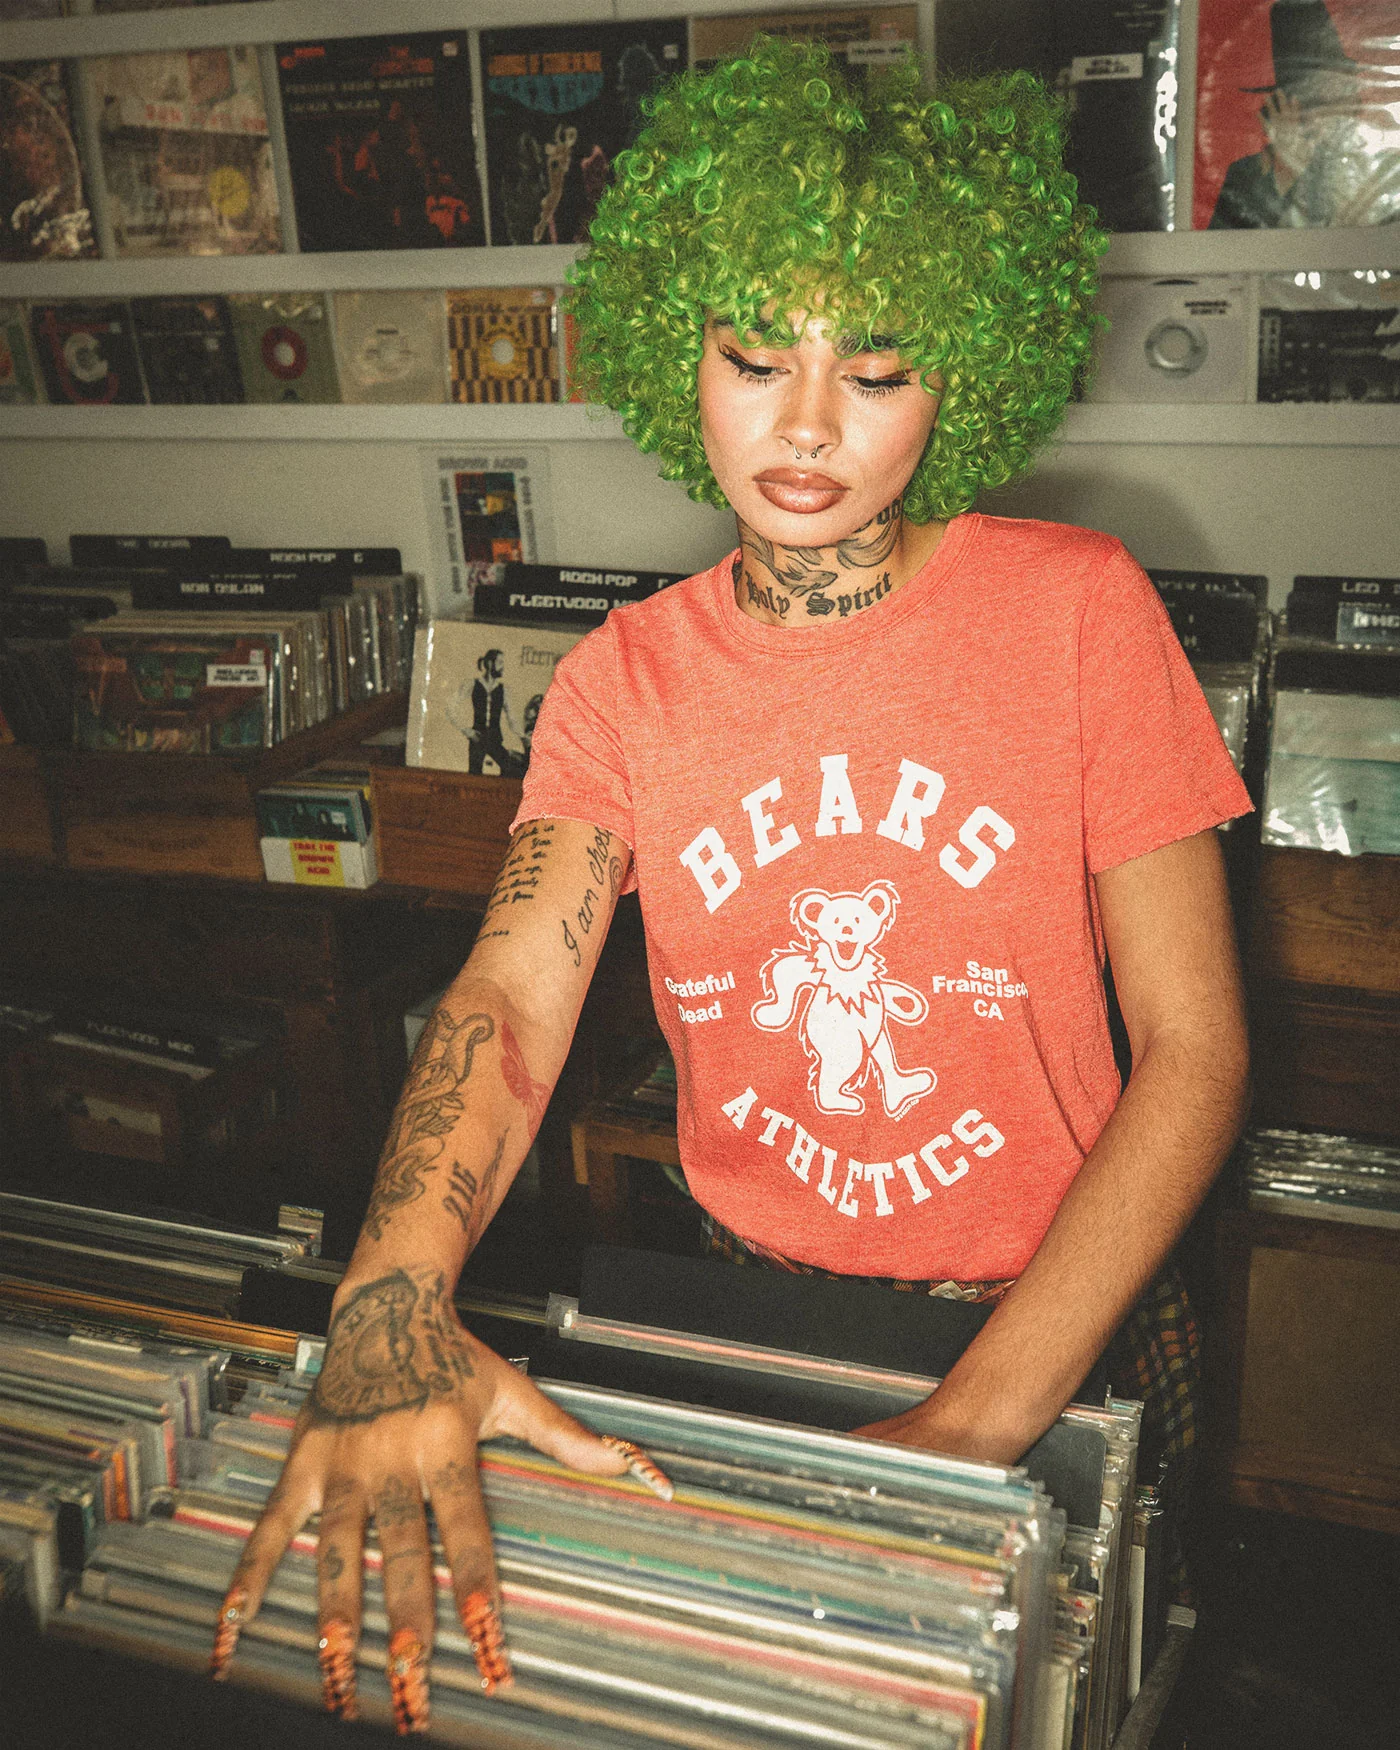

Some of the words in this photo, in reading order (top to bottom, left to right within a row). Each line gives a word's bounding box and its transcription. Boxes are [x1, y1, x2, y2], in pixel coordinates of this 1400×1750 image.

[559, 570, 603, 587] ROCK
[604, 574, 638, 588] POP
[806, 571, 892, 617] Spirit
[509, 593, 609, 611] FLEETWOOD
[679, 754, 1016, 914] BEARS
[577, 888, 599, 934] am
[589, 826, 613, 886] chos
[966, 960, 1009, 982] San
[973, 999, 1005, 1021] CA
[721, 1086, 1006, 1218] ATHLETICS
